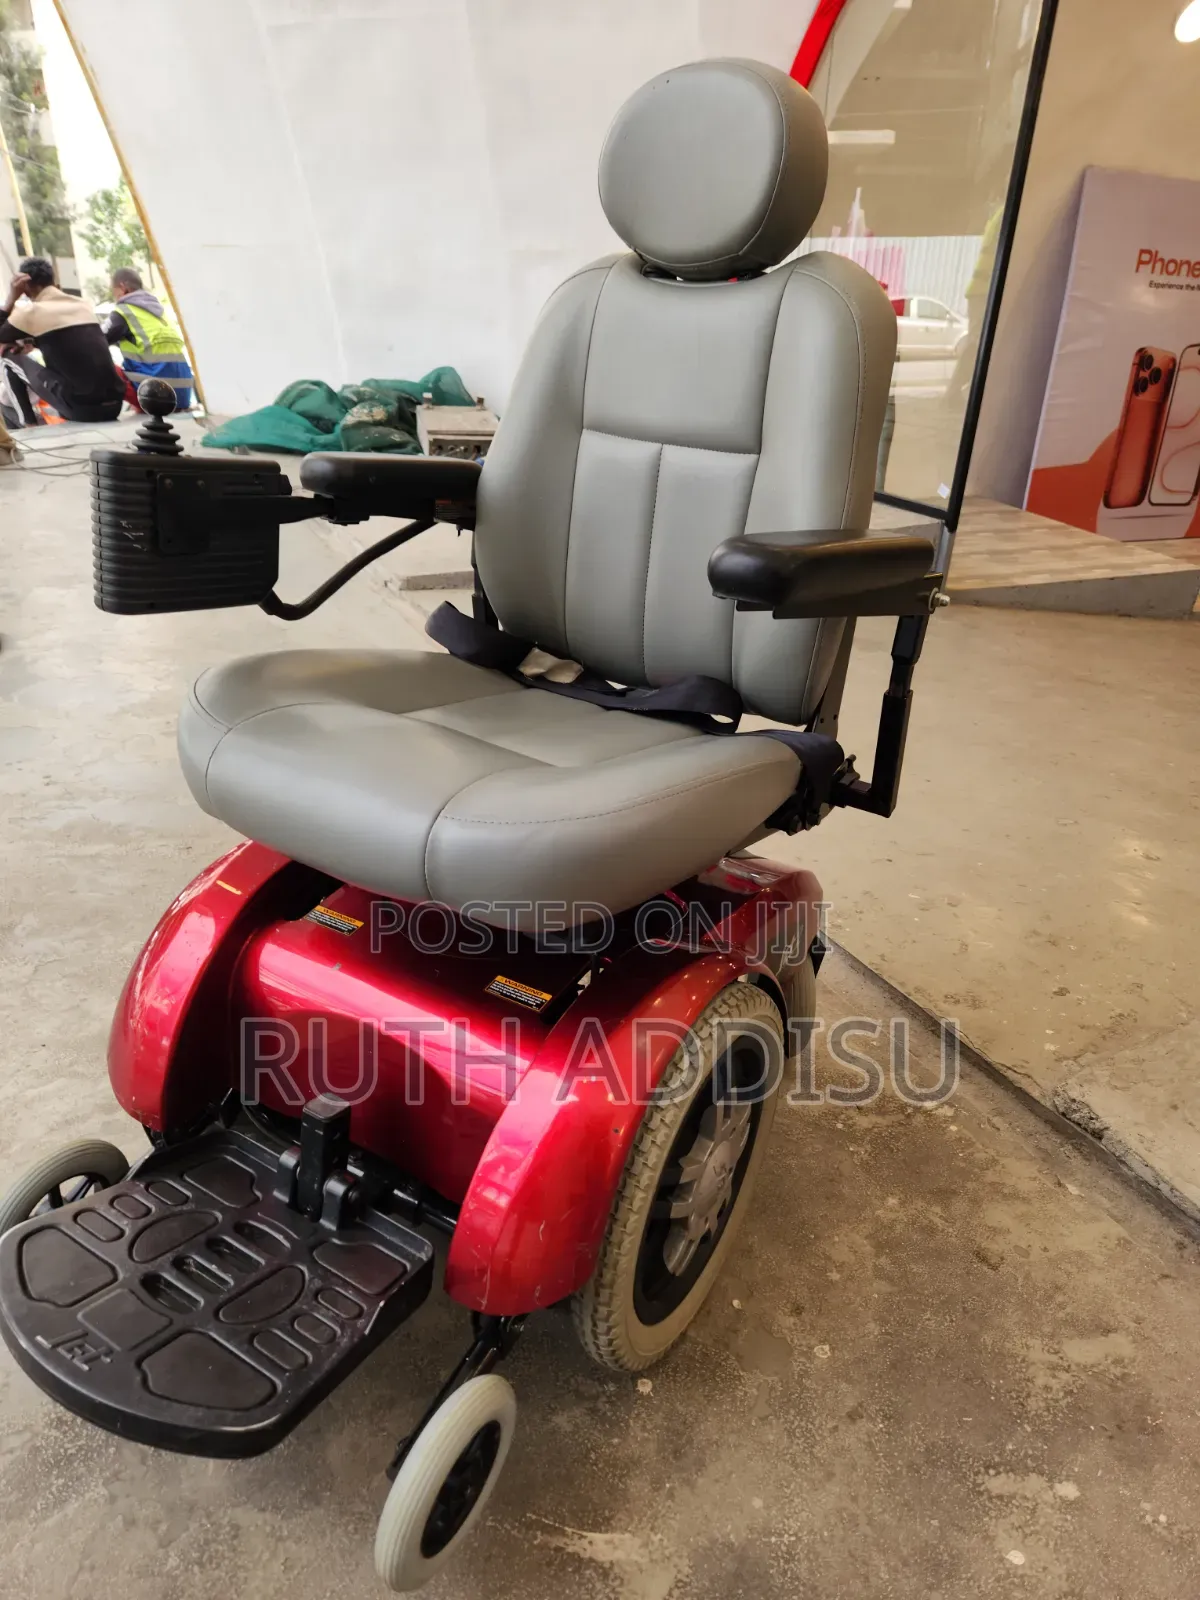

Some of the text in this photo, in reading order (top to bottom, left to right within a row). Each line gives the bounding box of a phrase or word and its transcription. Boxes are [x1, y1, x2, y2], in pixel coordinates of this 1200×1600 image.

[1134, 248, 1200, 278] Phone
[1149, 280, 1183, 290] Experience
[1185, 283, 1195, 291] the
[504, 979, 544, 996] WARNING
